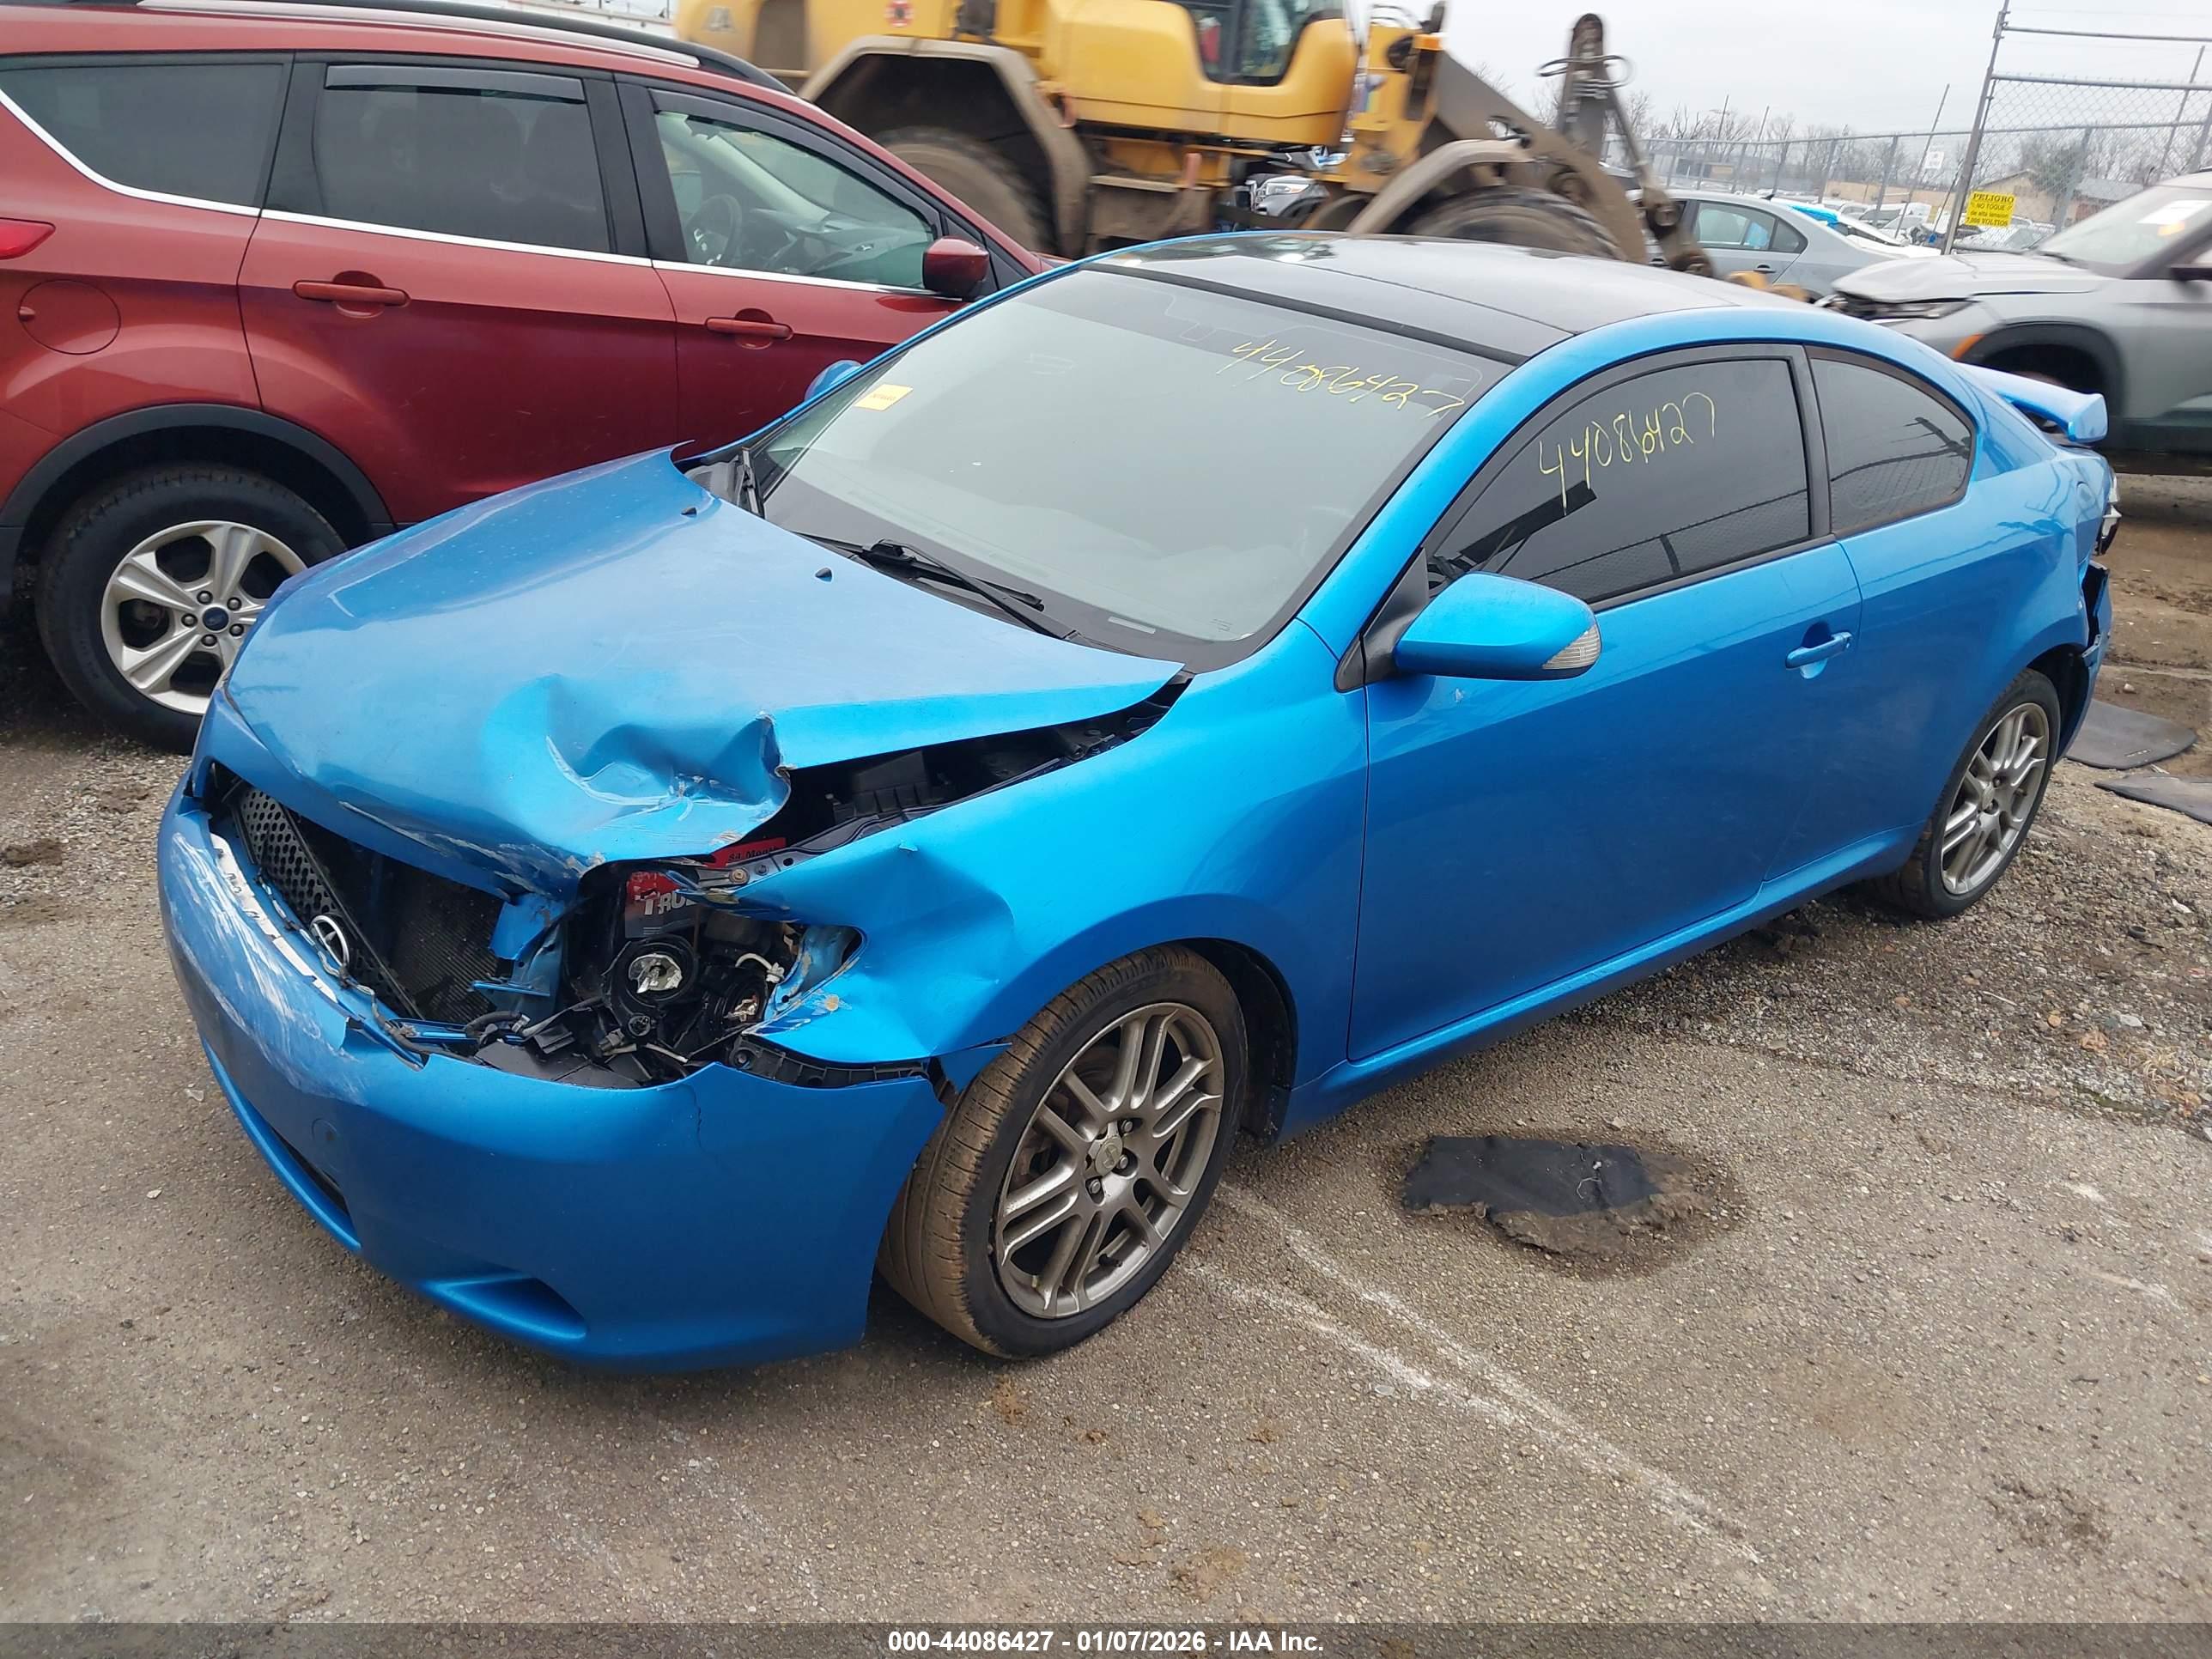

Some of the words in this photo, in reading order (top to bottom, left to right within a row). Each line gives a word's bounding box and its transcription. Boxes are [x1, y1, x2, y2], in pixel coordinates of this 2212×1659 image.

[1972, 193, 2014, 203] PELIGRO
[1217, 339, 1465, 419] 44086427
[1539, 392, 1716, 515] 44086427
